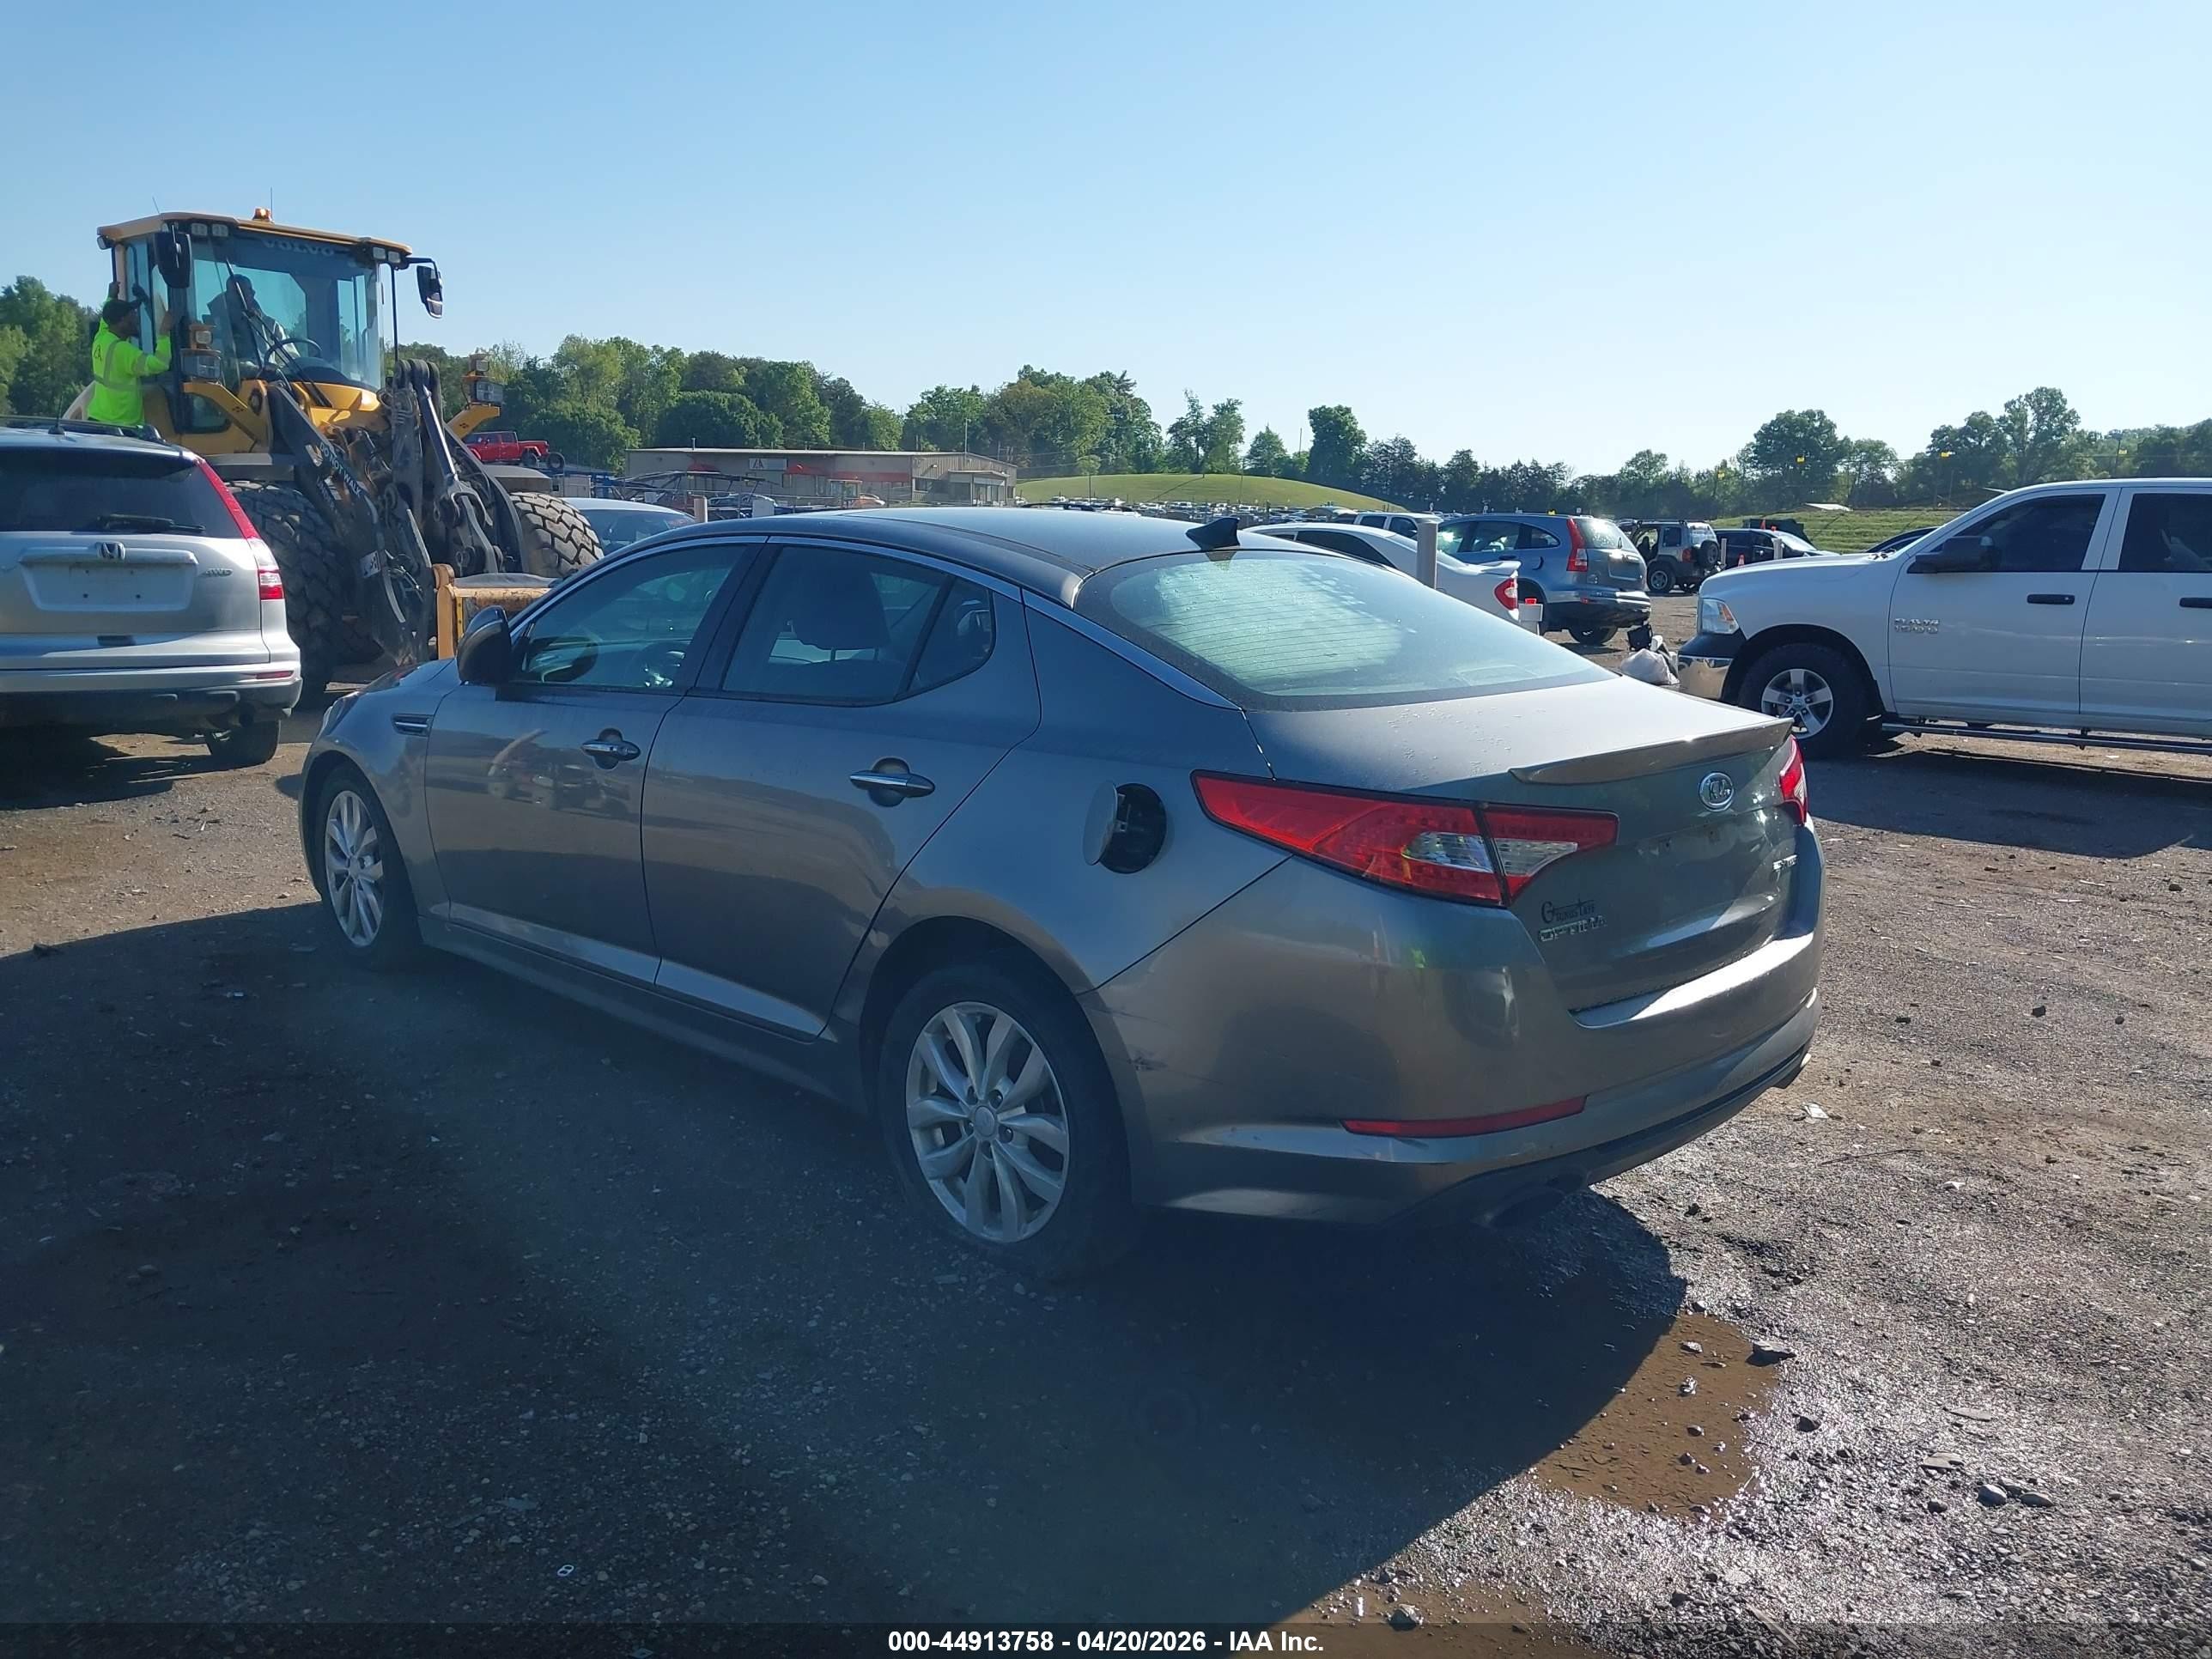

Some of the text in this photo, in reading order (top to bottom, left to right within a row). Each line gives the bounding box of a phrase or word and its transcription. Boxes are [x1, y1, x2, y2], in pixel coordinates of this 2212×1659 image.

[263, 240, 335, 257] VOLVO
[319, 441, 362, 498] DO NOT WALK
[1540, 915, 1608, 942] OPTIMA
